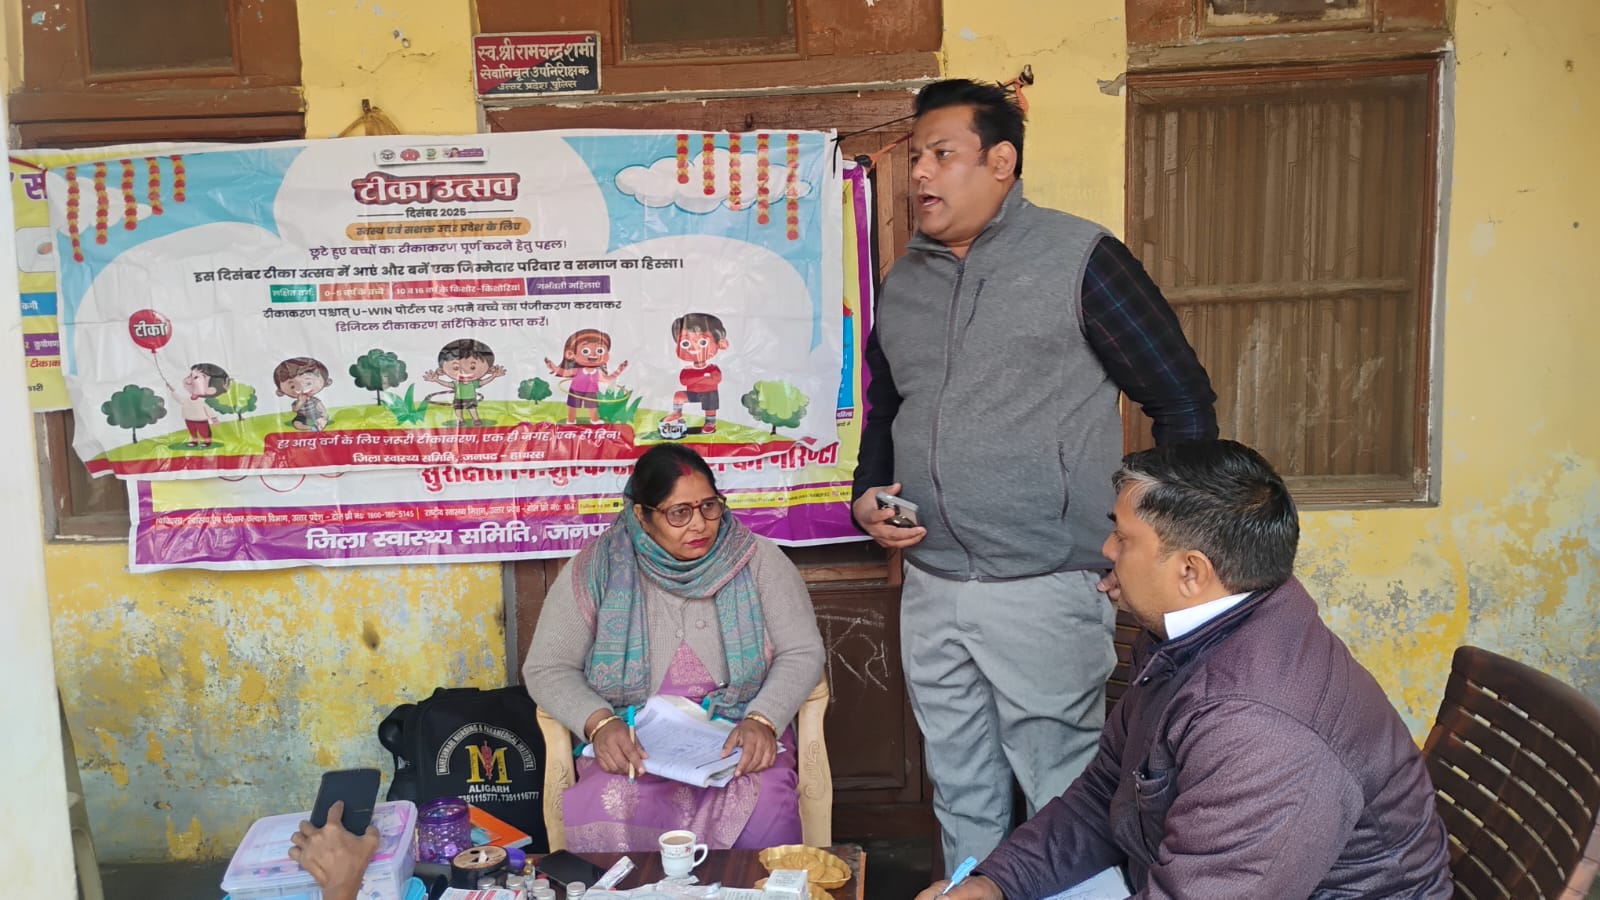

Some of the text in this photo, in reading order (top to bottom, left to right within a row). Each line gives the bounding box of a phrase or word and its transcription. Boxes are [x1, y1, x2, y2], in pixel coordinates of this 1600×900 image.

[564, 36, 595, 61] शर्मा
[550, 78, 576, 90] पुलिस
[354, 175, 518, 202] टीका उत्सव
[405, 207, 467, 218] दिसंबर 2025
[460, 222, 483, 233] प्रदेश
[486, 220, 498, 231] के
[499, 220, 522, 231] लिए
[309, 246, 328, 260] छूटे
[331, 246, 347, 259] हुए
[350, 244, 377, 255] बच्चों
[378, 245, 395, 254] का
[398, 242, 457, 255] टीकाकरण
[461, 239, 482, 254] पूर्ण
[483, 239, 513, 251] करने
[515, 239, 534, 253] हेतु
[194, 271, 215, 282] इस
[217, 267, 261, 280] दिसंबर
[262, 266, 297, 279] टीका
[299, 267, 336, 279] उत्सव
[337, 264, 349, 277] में
[353, 263, 378, 276] आएं
[381, 262, 405, 276] और
[407, 261, 430, 275] बनें
[431, 263, 455, 275] एक
[456, 260, 514, 274] जिम्मेदार
[516, 258, 561, 272] परिवार
[563, 260, 573, 271] व
[575, 259, 617, 270] समाज
[620, 258, 639, 269] का
[262, 300, 622, 319] टीकाकरण पश्चात् U-WIN पोर्टल पर अपने बच्चे का पंजीकरण करवाकर
[132, 321, 168, 338] टीका
[336, 320, 380, 332] डिजिटल
[382, 319, 438, 331] टीकाकरण
[441, 316, 497, 329] सर्टिफिकेट
[499, 316, 524, 327] प्राप्त
[277, 438, 289, 449] हर
[292, 437, 317, 450] आयु
[320, 434, 340, 446] वर्ग
[341, 434, 354, 446] के
[356, 433, 380, 445] लिए
[483, 433, 505, 443] एक
[506, 430, 519, 442] ही
[555, 430, 577, 440] एक
[579, 428, 593, 441] ही
[352, 452, 381, 463] जिला
[383, 454, 420, 463] स्वास्थ्य
[462, 452, 498, 461] जनपद
[305, 527, 368, 550] जिला
[372, 529, 454, 548] स्वास्थ्य
[545, 522, 612, 541] जनप
[465, 745, 513, 784] M
[468, 784, 511, 793] ALIGARH
